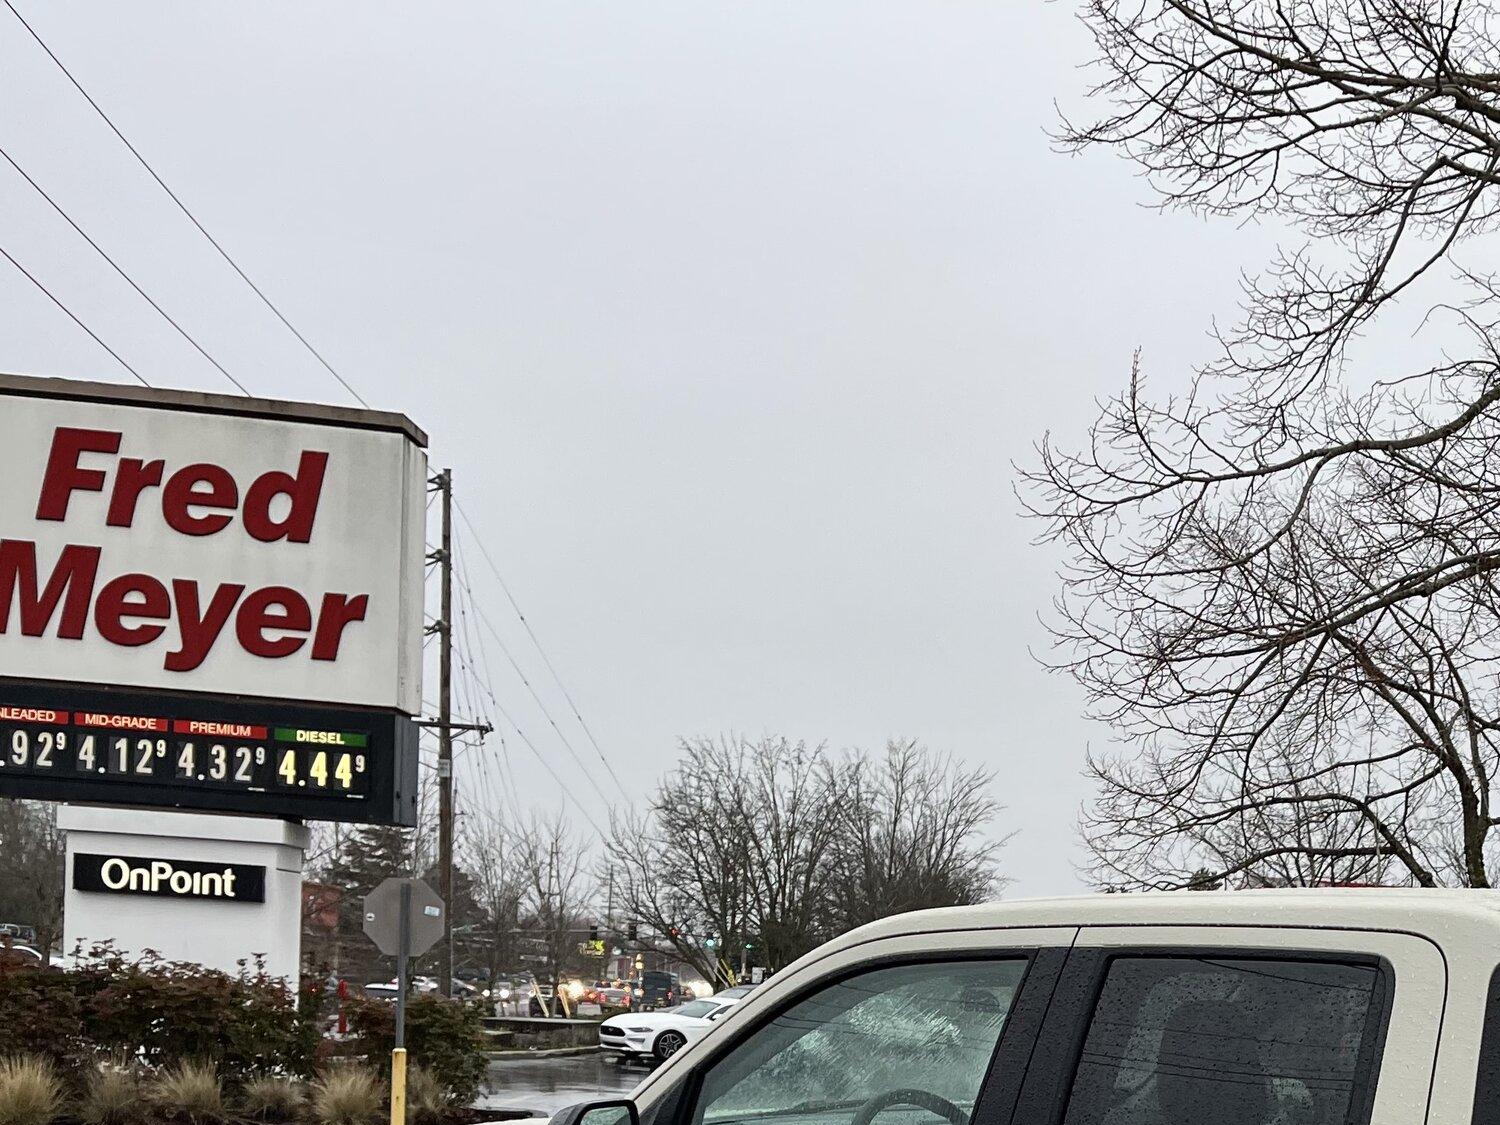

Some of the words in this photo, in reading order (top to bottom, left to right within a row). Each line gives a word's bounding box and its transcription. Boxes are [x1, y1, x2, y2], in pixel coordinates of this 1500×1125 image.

[36, 426, 329, 544] Fred
[0, 538, 369, 672] Meyer
[85, 714, 157, 730] MID-GRADE
[190, 721, 252, 737] PREMIUM
[296, 729, 345, 745] DIESEL
[101, 858, 236, 898] OnPoint
